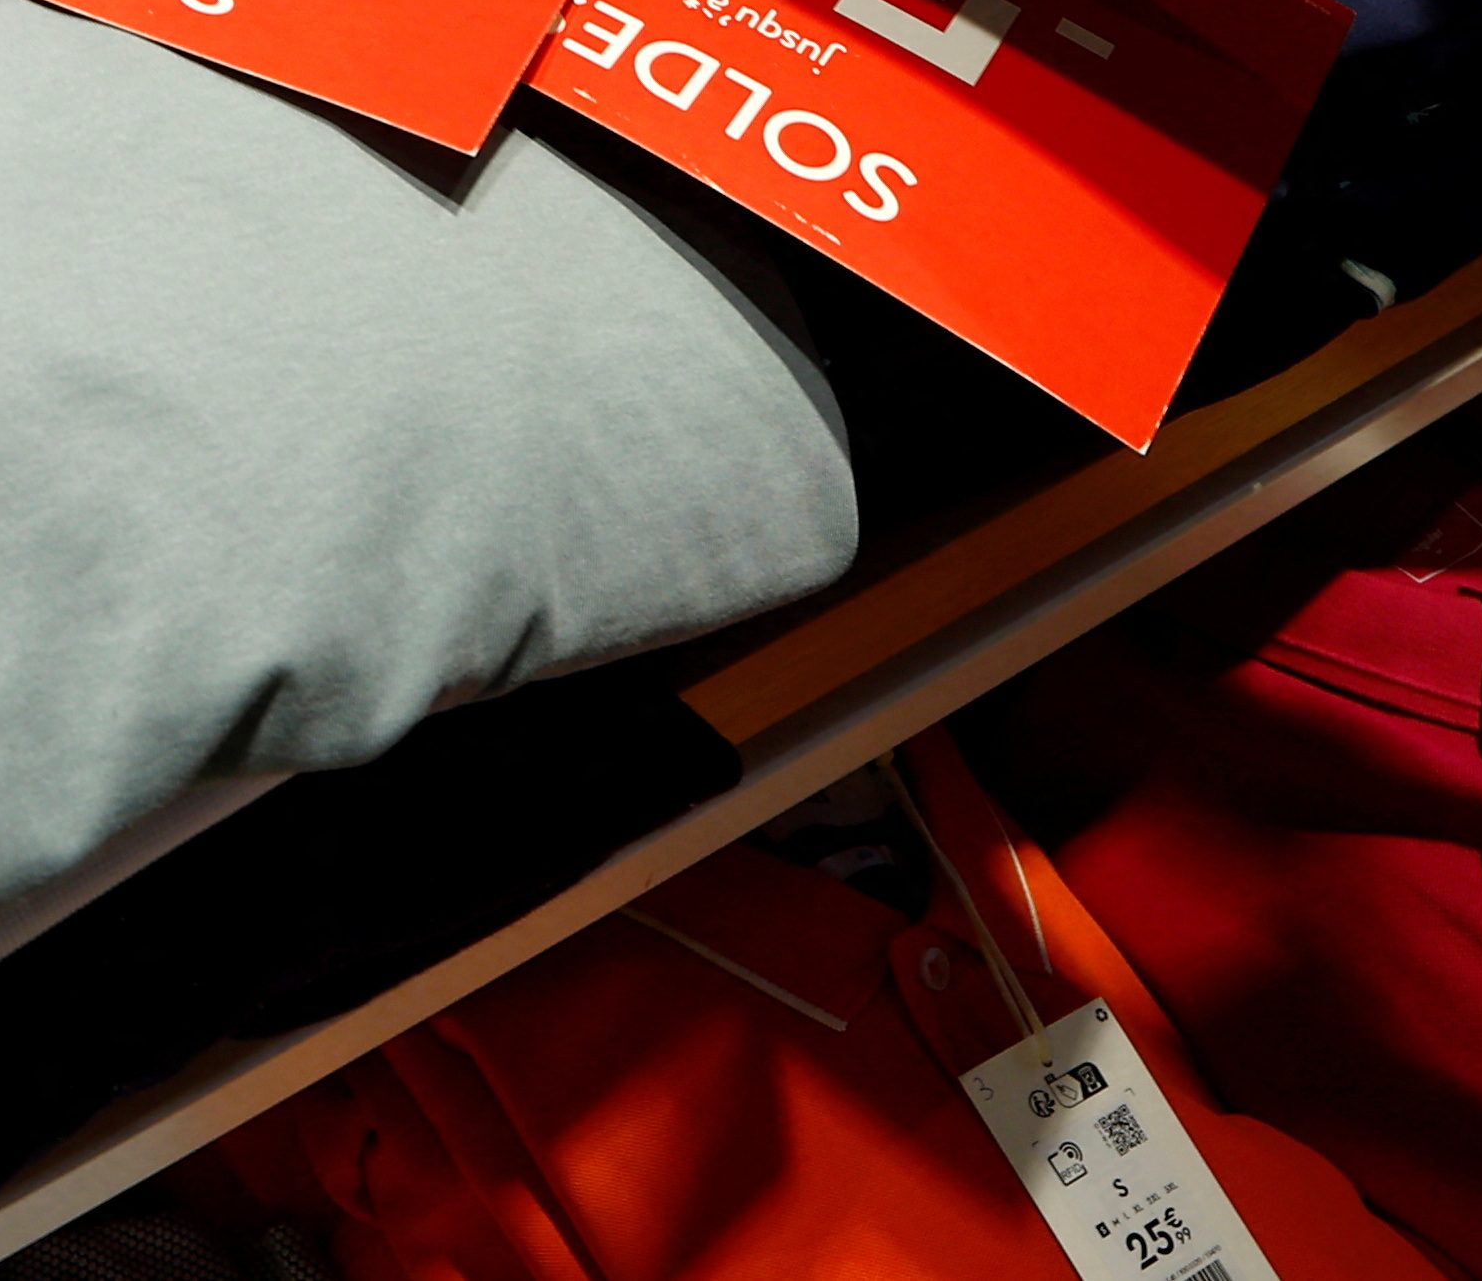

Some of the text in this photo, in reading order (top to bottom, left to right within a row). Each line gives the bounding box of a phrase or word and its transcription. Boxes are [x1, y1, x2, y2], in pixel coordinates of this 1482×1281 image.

[1060, 1162, 1084, 1181] RFID
[1113, 1178, 1129, 1198] S
[1133, 1203, 1144, 1214] XL
